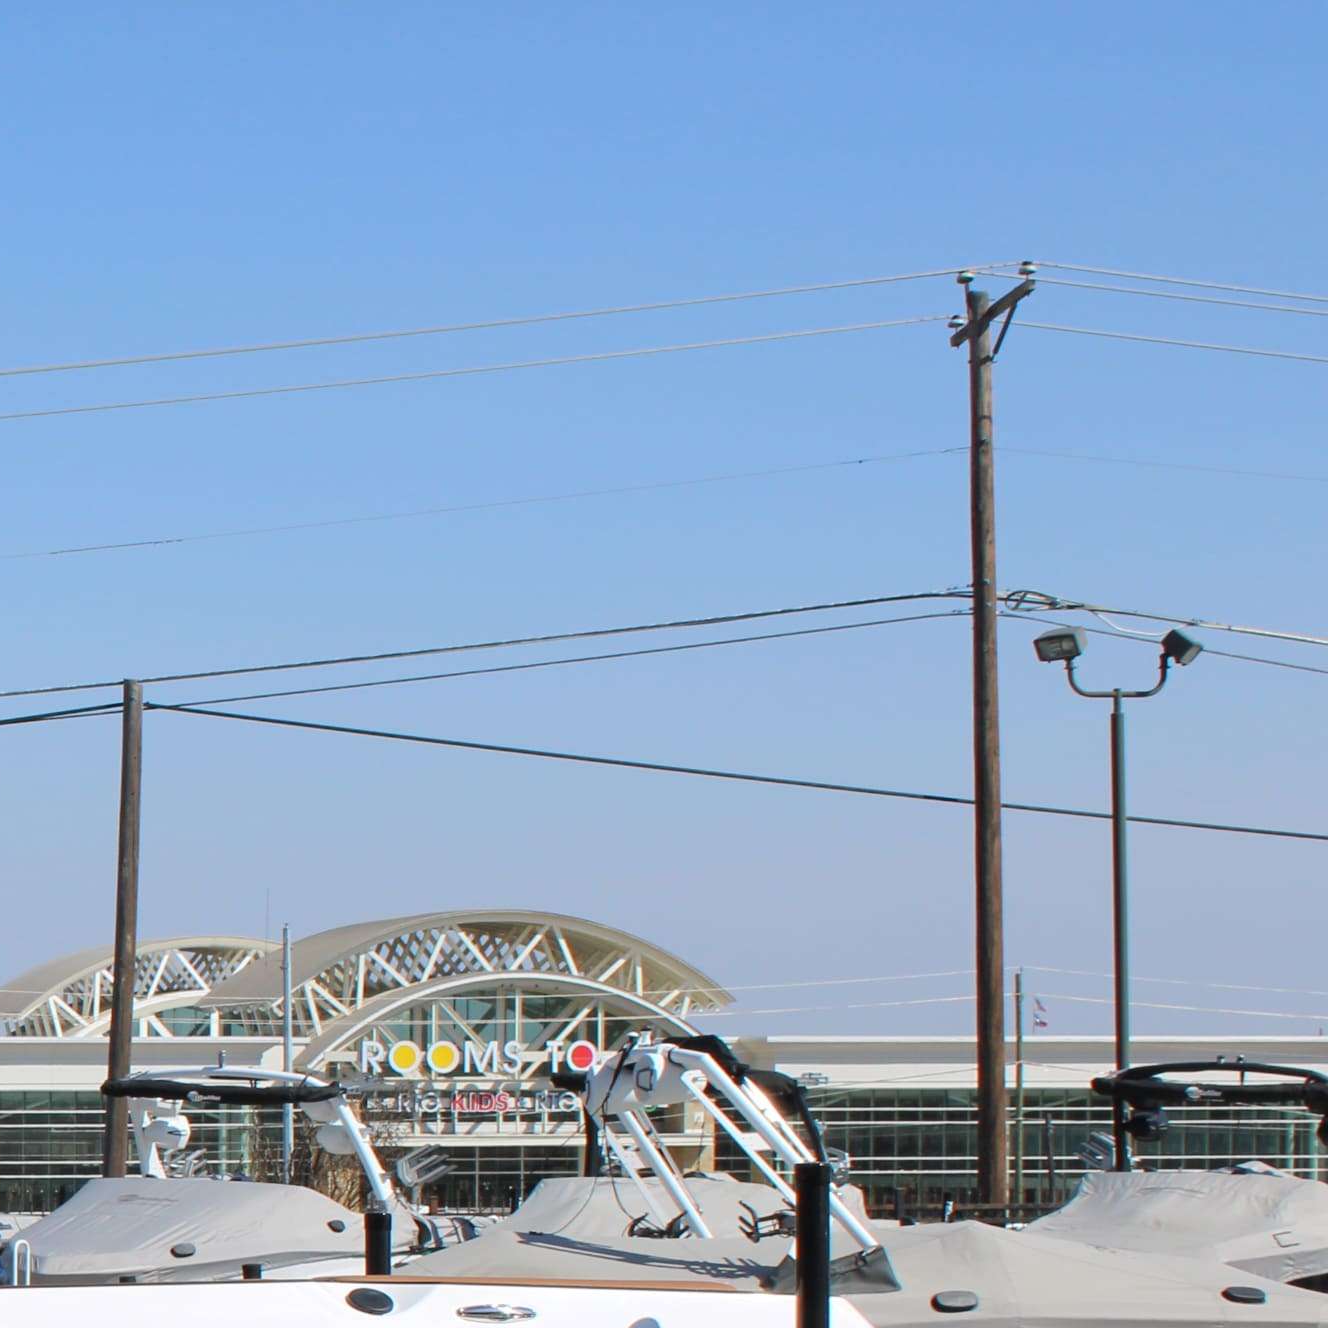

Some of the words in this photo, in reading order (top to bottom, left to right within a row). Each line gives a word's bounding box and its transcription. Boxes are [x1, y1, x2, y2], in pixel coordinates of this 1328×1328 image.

[361, 1040, 523, 1074] ROOMS
[546, 1040, 595, 1074] TO
[451, 1091, 509, 1113] KIDS
